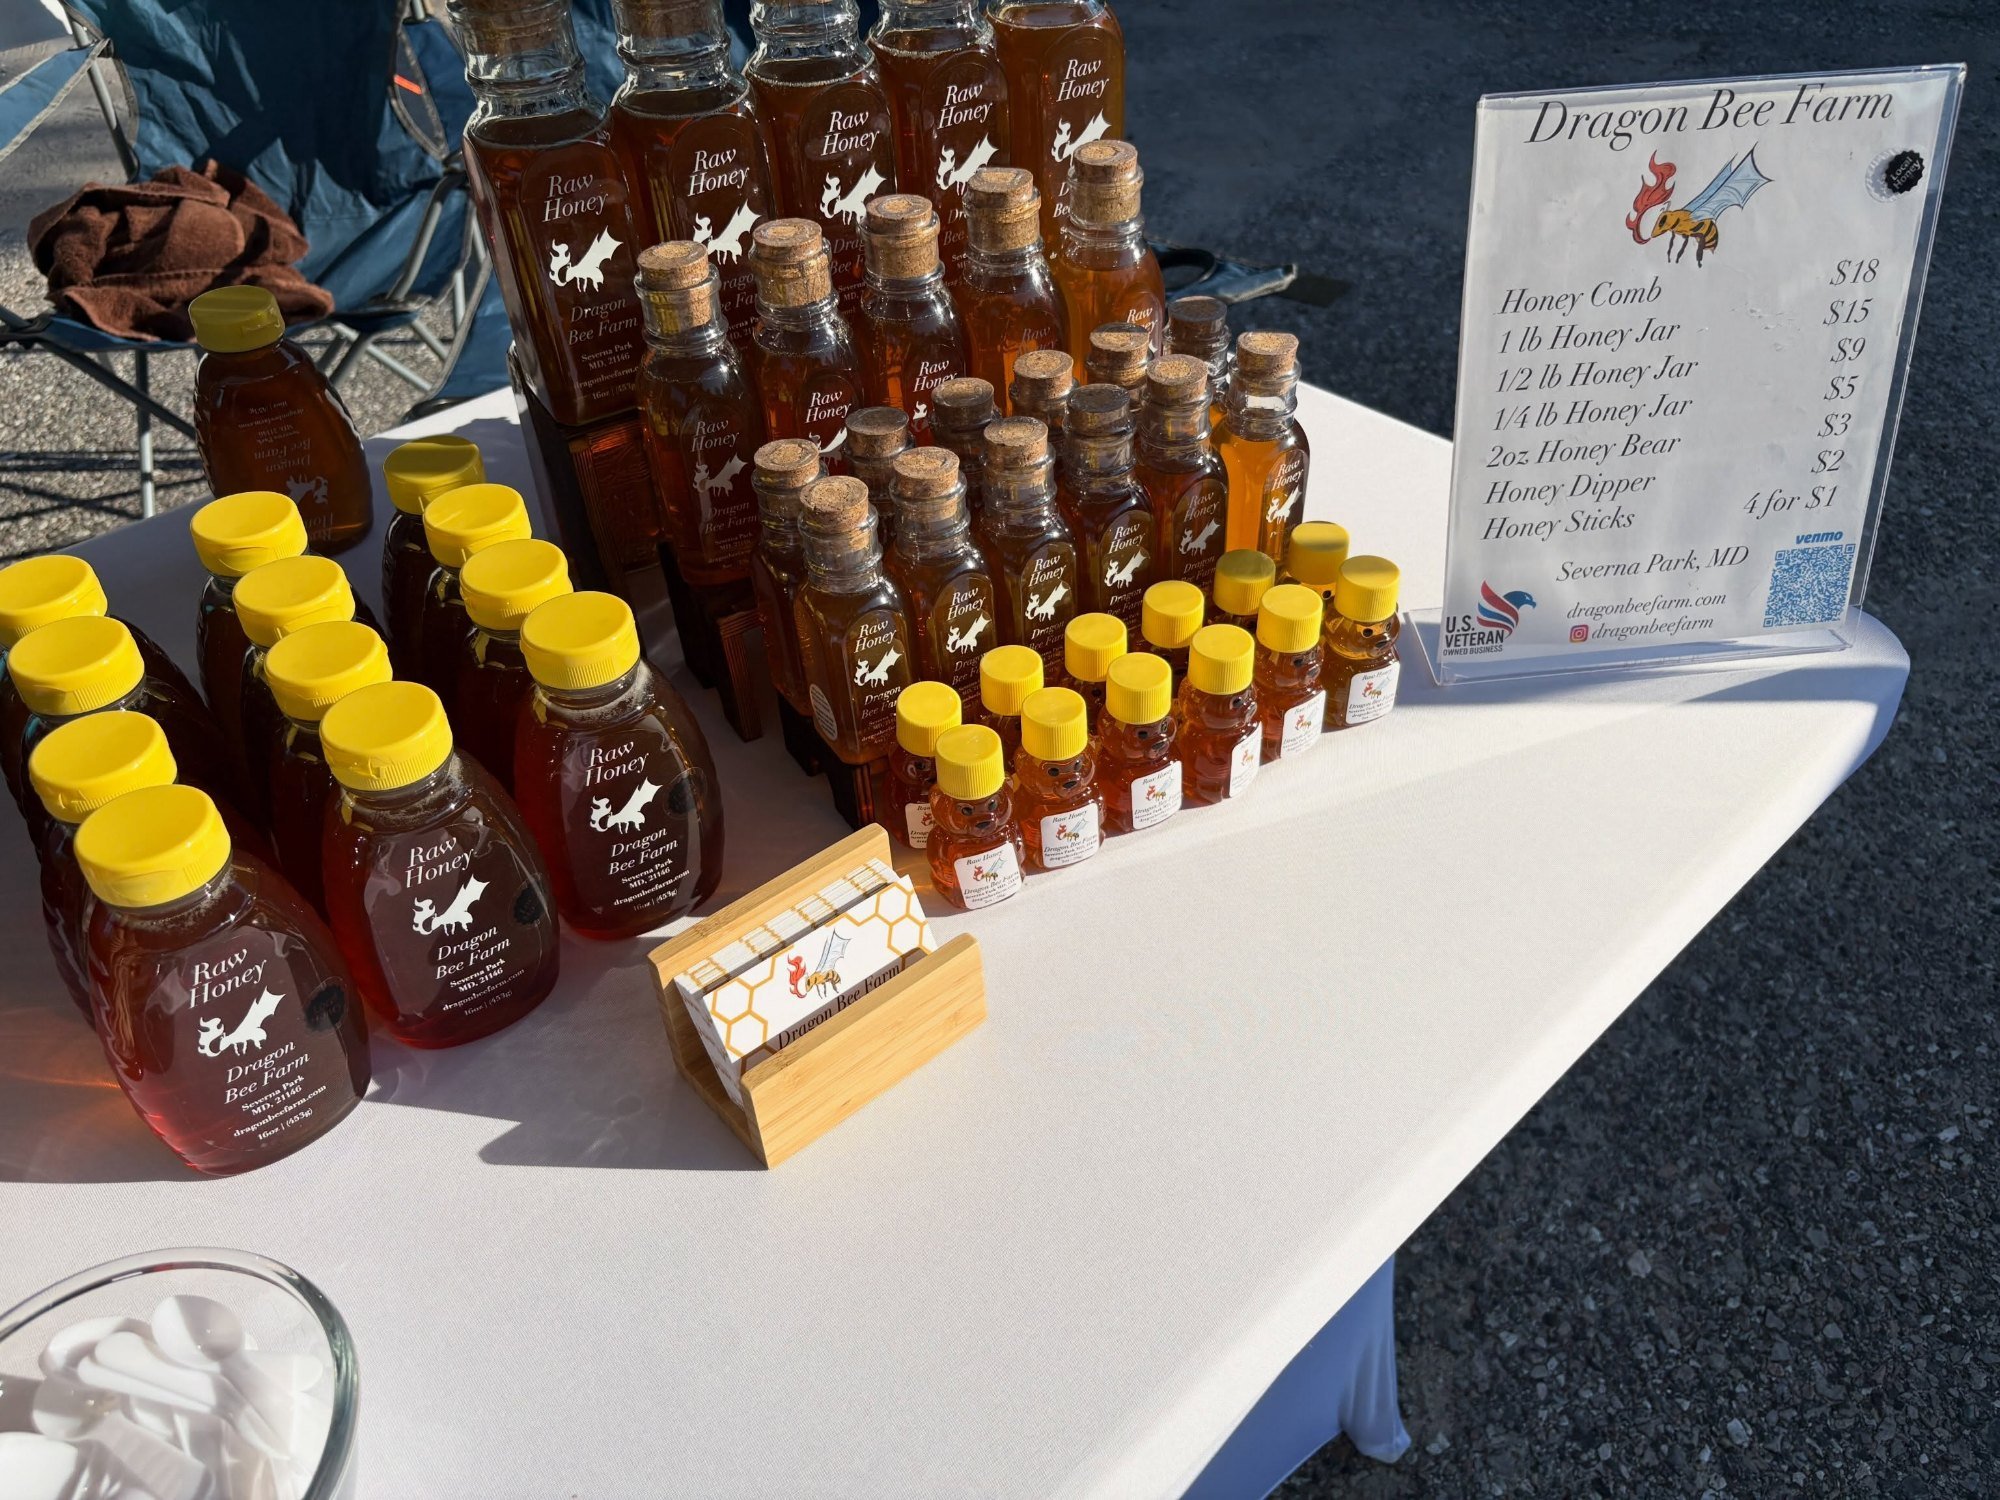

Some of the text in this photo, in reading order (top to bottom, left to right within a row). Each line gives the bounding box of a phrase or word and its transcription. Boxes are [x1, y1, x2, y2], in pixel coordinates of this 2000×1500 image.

[1065, 58, 1102, 80] Raw
[945, 83, 983, 107] Raw
[1056, 77, 1110, 102] Honey
[828, 110, 870, 134] Raw
[937, 102, 993, 130] Honey
[1523, 82, 1893, 151] Dragon Bee Farm
[820, 129, 880, 157] Honey
[693, 149, 737, 174] Raw
[1891, 156, 1912, 180] Local
[1893, 160, 1920, 189] Honey
[548, 174, 594, 198] Raw
[687, 167, 750, 198] Honey
[542, 193, 609, 223] Honey
[1830, 258, 1879, 286] $18
[1496, 276, 1662, 316] Honey Comb
[571, 298, 627, 323] Dragon
[1126, 307, 1153, 323] Raw
[1823, 299, 1870, 326] $15
[569, 315, 639, 347] Bee Farm
[1500, 318, 1680, 353] 1 lb Honey Jar
[1830, 337, 1866, 363] $9
[919, 359, 950, 377] Raw
[1495, 355, 1699, 395] 1/2 lb Honey Jar
[912, 373, 958, 393] Honey
[1823, 376, 1857, 401] $5
[810, 390, 843, 408] Raw
[805, 403, 852, 424] Honey
[1494, 394, 1693, 432] 1/4 lb Honey Jar
[695, 419, 729, 437] Raw
[1817, 414, 1851, 439] $3
[692, 431, 740, 452] Honey
[1486, 434, 1681, 470] 2oz Honey Bear
[1279, 460, 1300, 478] Raw
[1811, 449, 1845, 475] $2
[1272, 469, 1304, 491] Honey
[1483, 473, 1656, 507] Honey Dipper
[1184, 501, 1221, 524] Honey
[1188, 492, 1215, 508] Raw
[1743, 485, 1838, 522] 4 for $1
[1114, 523, 1141, 540] Raw
[1481, 509, 1635, 543] Honey Sticks
[1796, 530, 1843, 545] venmo
[1108, 532, 1146, 554] Honey
[1028, 564, 1067, 588] Honey
[1033, 555, 1061, 573] Raw
[1556, 545, 1749, 583] Severna Park, MD
[947, 596, 986, 621] Honey
[951, 587, 979, 606] Raw
[1567, 590, 1726, 622] dragonbeefarm.com
[859, 619, 889, 638] Raw
[1446, 614, 1475, 633] U.S.
[1591, 614, 1713, 642] dragonbeefarm
[854, 629, 897, 653] Honey
[1443, 644, 1503, 656] OWNED BUSINESS
[1445, 631, 1504, 647] VETERAN
[864, 686, 901, 706] Dragon
[589, 741, 634, 768] Raw
[586, 753, 649, 787] Honey
[407, 837, 457, 868] Raw
[611, 827, 668, 858] Dragon
[405, 849, 474, 889] Honey
[608, 839, 678, 876] Bee Farm
[621, 858, 673, 884] Severna Park
[648, 866, 671, 882] 21146
[613, 869, 690, 906] dragonbeefarm.com
[437, 926, 498, 961] Dragon
[192, 948, 248, 986] Raw
[435, 937, 511, 980] Bee Farm
[188, 959, 268, 1010] Honey
[450, 958, 506, 988] Severna Park
[479, 967, 504, 984] 21146
[442, 968, 525, 1012] dragonbeefarm.com
[776, 962, 901, 1051] Dragon Bee Farm
[226, 1041, 296, 1084] Dragon
[224, 1052, 311, 1105] Bee Farm
[241, 1074, 305, 1112] Severna Park
[274, 1085, 302, 1104] 21146
[233, 1085, 327, 1137] dragonbeefarm.com
[286, 1106, 313, 1128] (453g)
